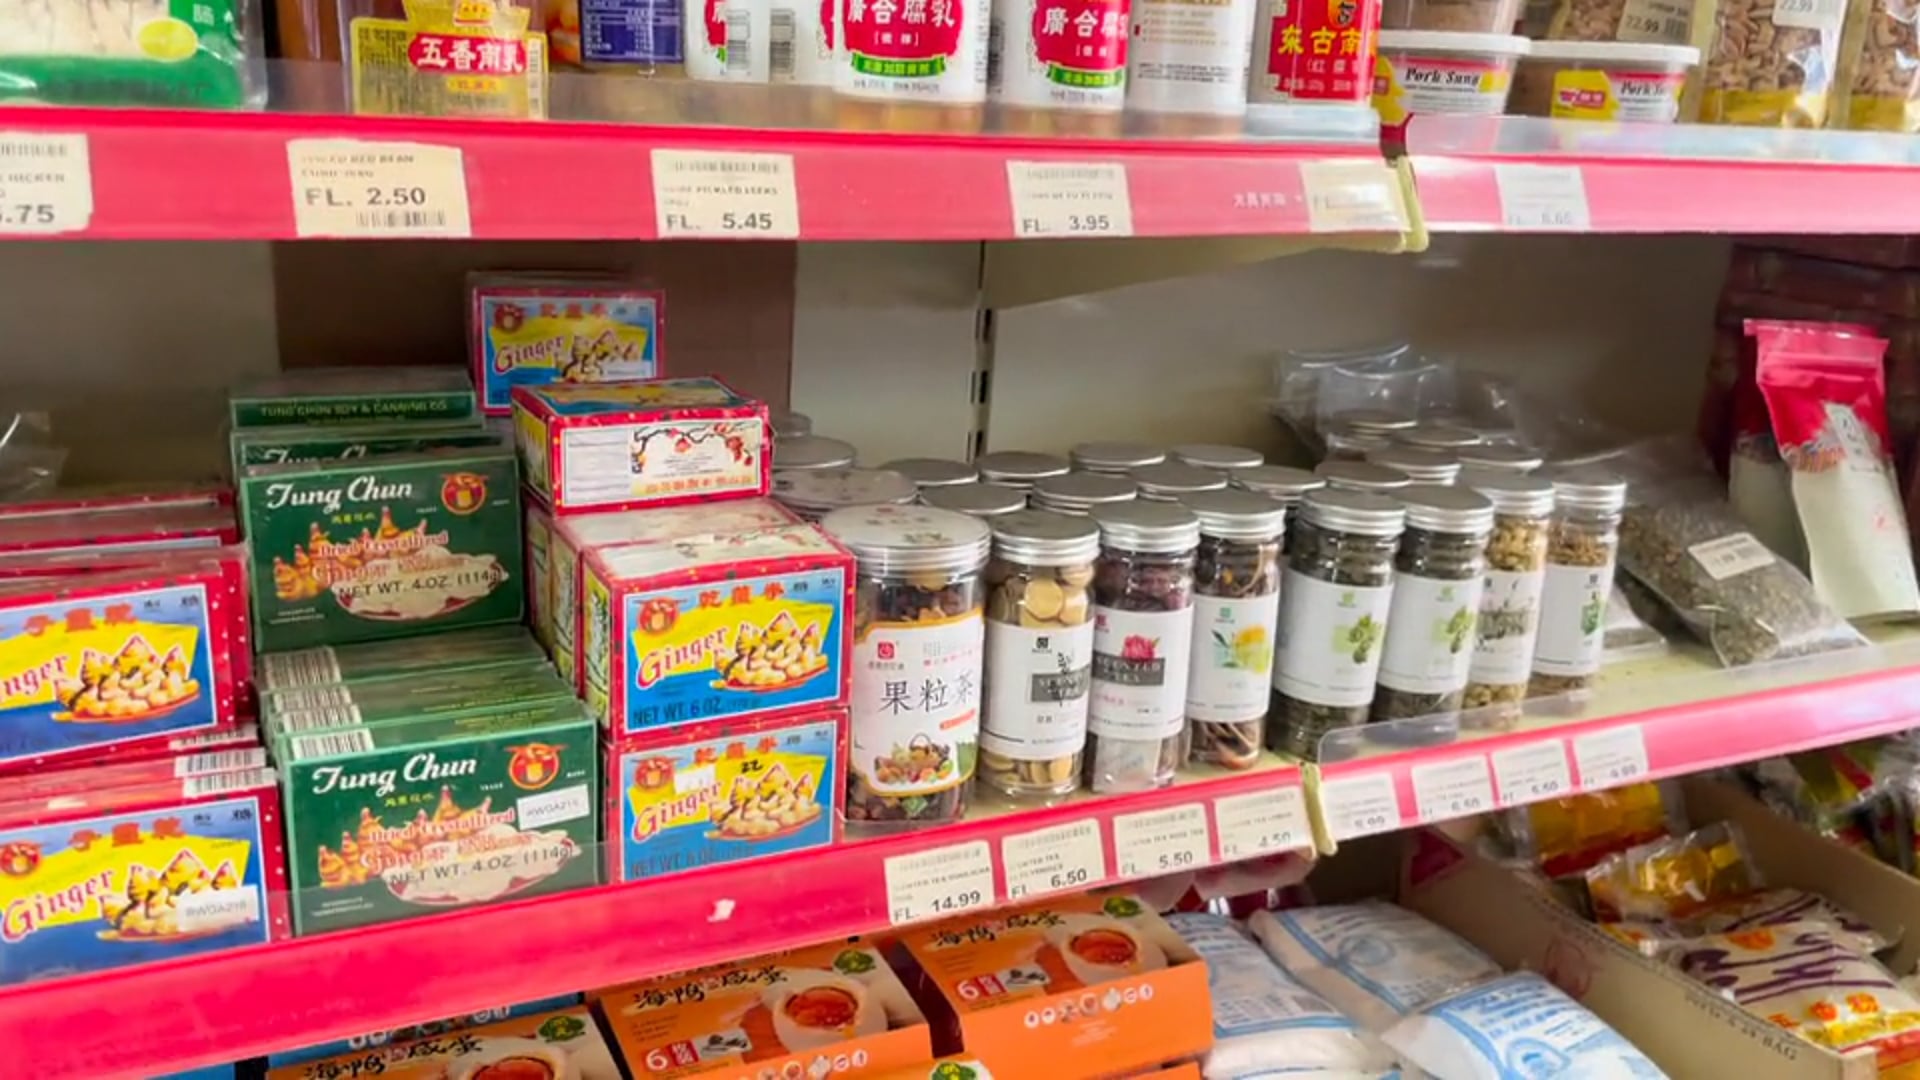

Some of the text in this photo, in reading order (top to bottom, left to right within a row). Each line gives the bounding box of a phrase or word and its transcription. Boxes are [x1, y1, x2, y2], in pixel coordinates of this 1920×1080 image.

[1405, 68, 1441, 84] Pork
[1621, 82, 1650, 96] Pork
[305, 187, 426, 206] FL. 2.50
[722, 212, 773, 231] 5.45
[1069, 214, 1110, 231] 3.95
[494, 335, 564, 374] Ginger
[265, 475, 412, 514] Tung Chun
[636, 624, 730, 690] Ginger
[878, 668, 978, 716] 果粒茶
[634, 705, 659, 727] NET
[689, 700, 699, 714] 6
[312, 765, 396, 801] Tung
[403, 752, 477, 783] Chun
[632, 781, 723, 843] Ginger
[1159, 850, 1192, 869] 5.50
[1051, 868, 1087, 889] 6.50
[1, 869, 114, 943] Ginger
[932, 890, 981, 913] 14.99
[957, 980, 979, 1000] 6
[646, 1047, 669, 1071] 6
